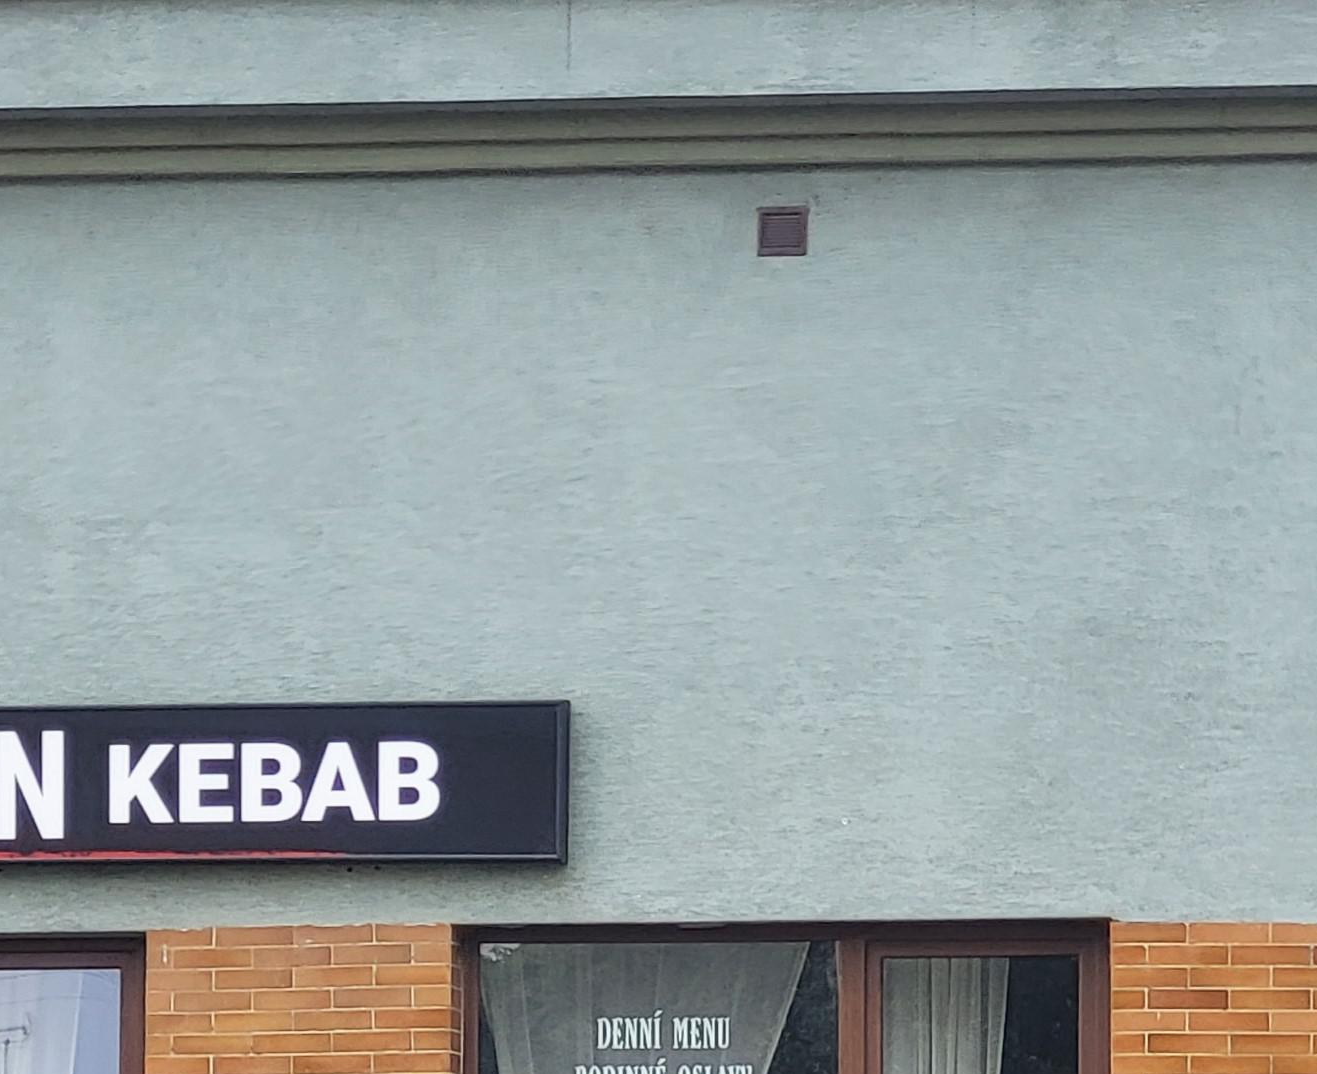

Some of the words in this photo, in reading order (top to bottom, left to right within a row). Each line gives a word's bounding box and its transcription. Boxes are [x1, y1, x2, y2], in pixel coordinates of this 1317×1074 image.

[108, 739, 441, 825] KEBAB
[596, 1010, 664, 1050] DENNÍ
[672, 1016, 731, 1050] MENU
